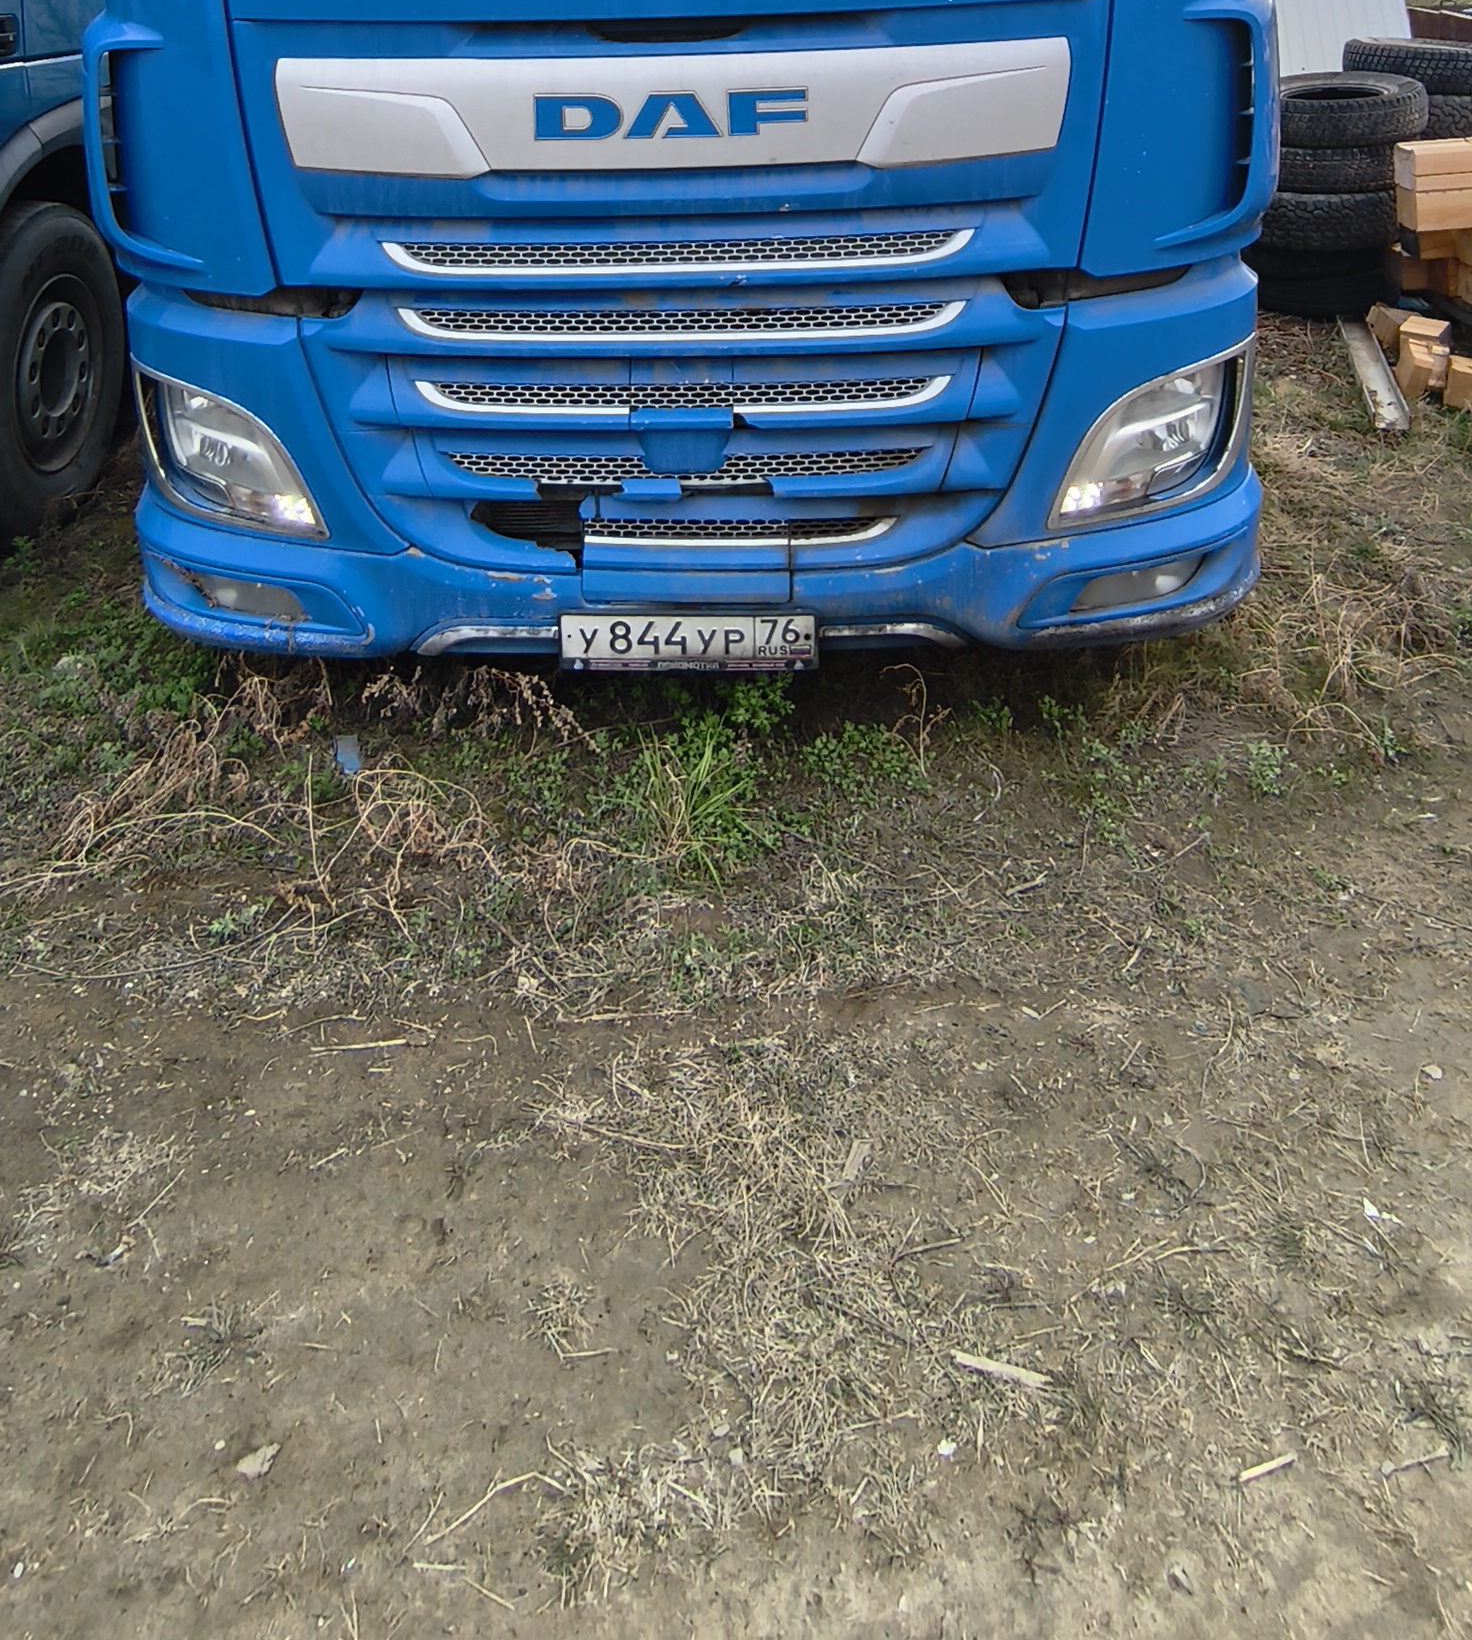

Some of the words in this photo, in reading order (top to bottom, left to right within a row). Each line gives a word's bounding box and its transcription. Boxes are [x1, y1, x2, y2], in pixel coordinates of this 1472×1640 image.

[533, 86, 808, 140] DAF
[760, 619, 800, 644] 76
[758, 645, 787, 655] RUS
